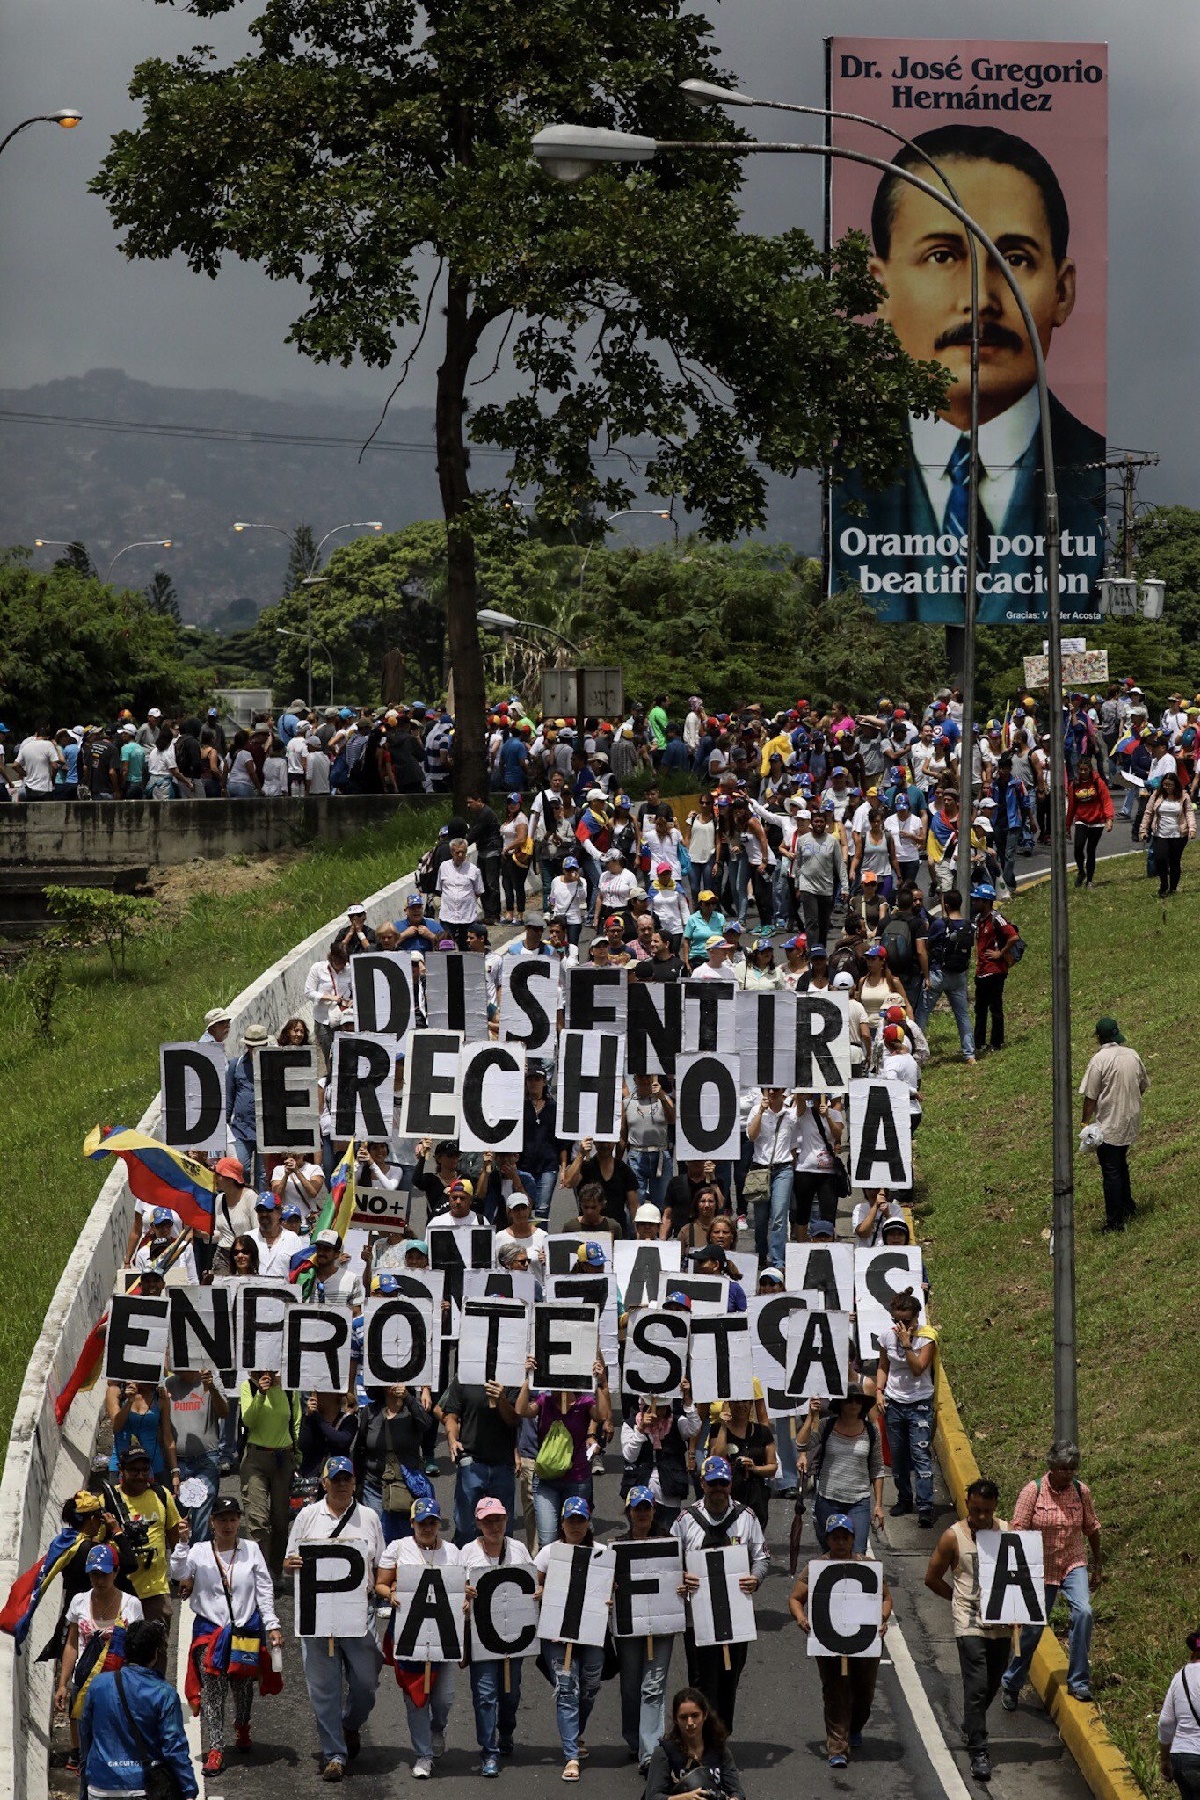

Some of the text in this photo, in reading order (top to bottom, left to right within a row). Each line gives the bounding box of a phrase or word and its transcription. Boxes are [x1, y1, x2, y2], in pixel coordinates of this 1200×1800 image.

[840, 54, 1103, 88] Dr. José Gregorio
[891, 84, 1052, 111] Hernández
[988, 534, 1046, 564] por
[1058, 528, 1097, 557] tu
[1005, 610, 1040, 620] Gracias:
[1072, 610, 1101, 620] Acosta
[163, 1034, 737, 1153] DERECHO
